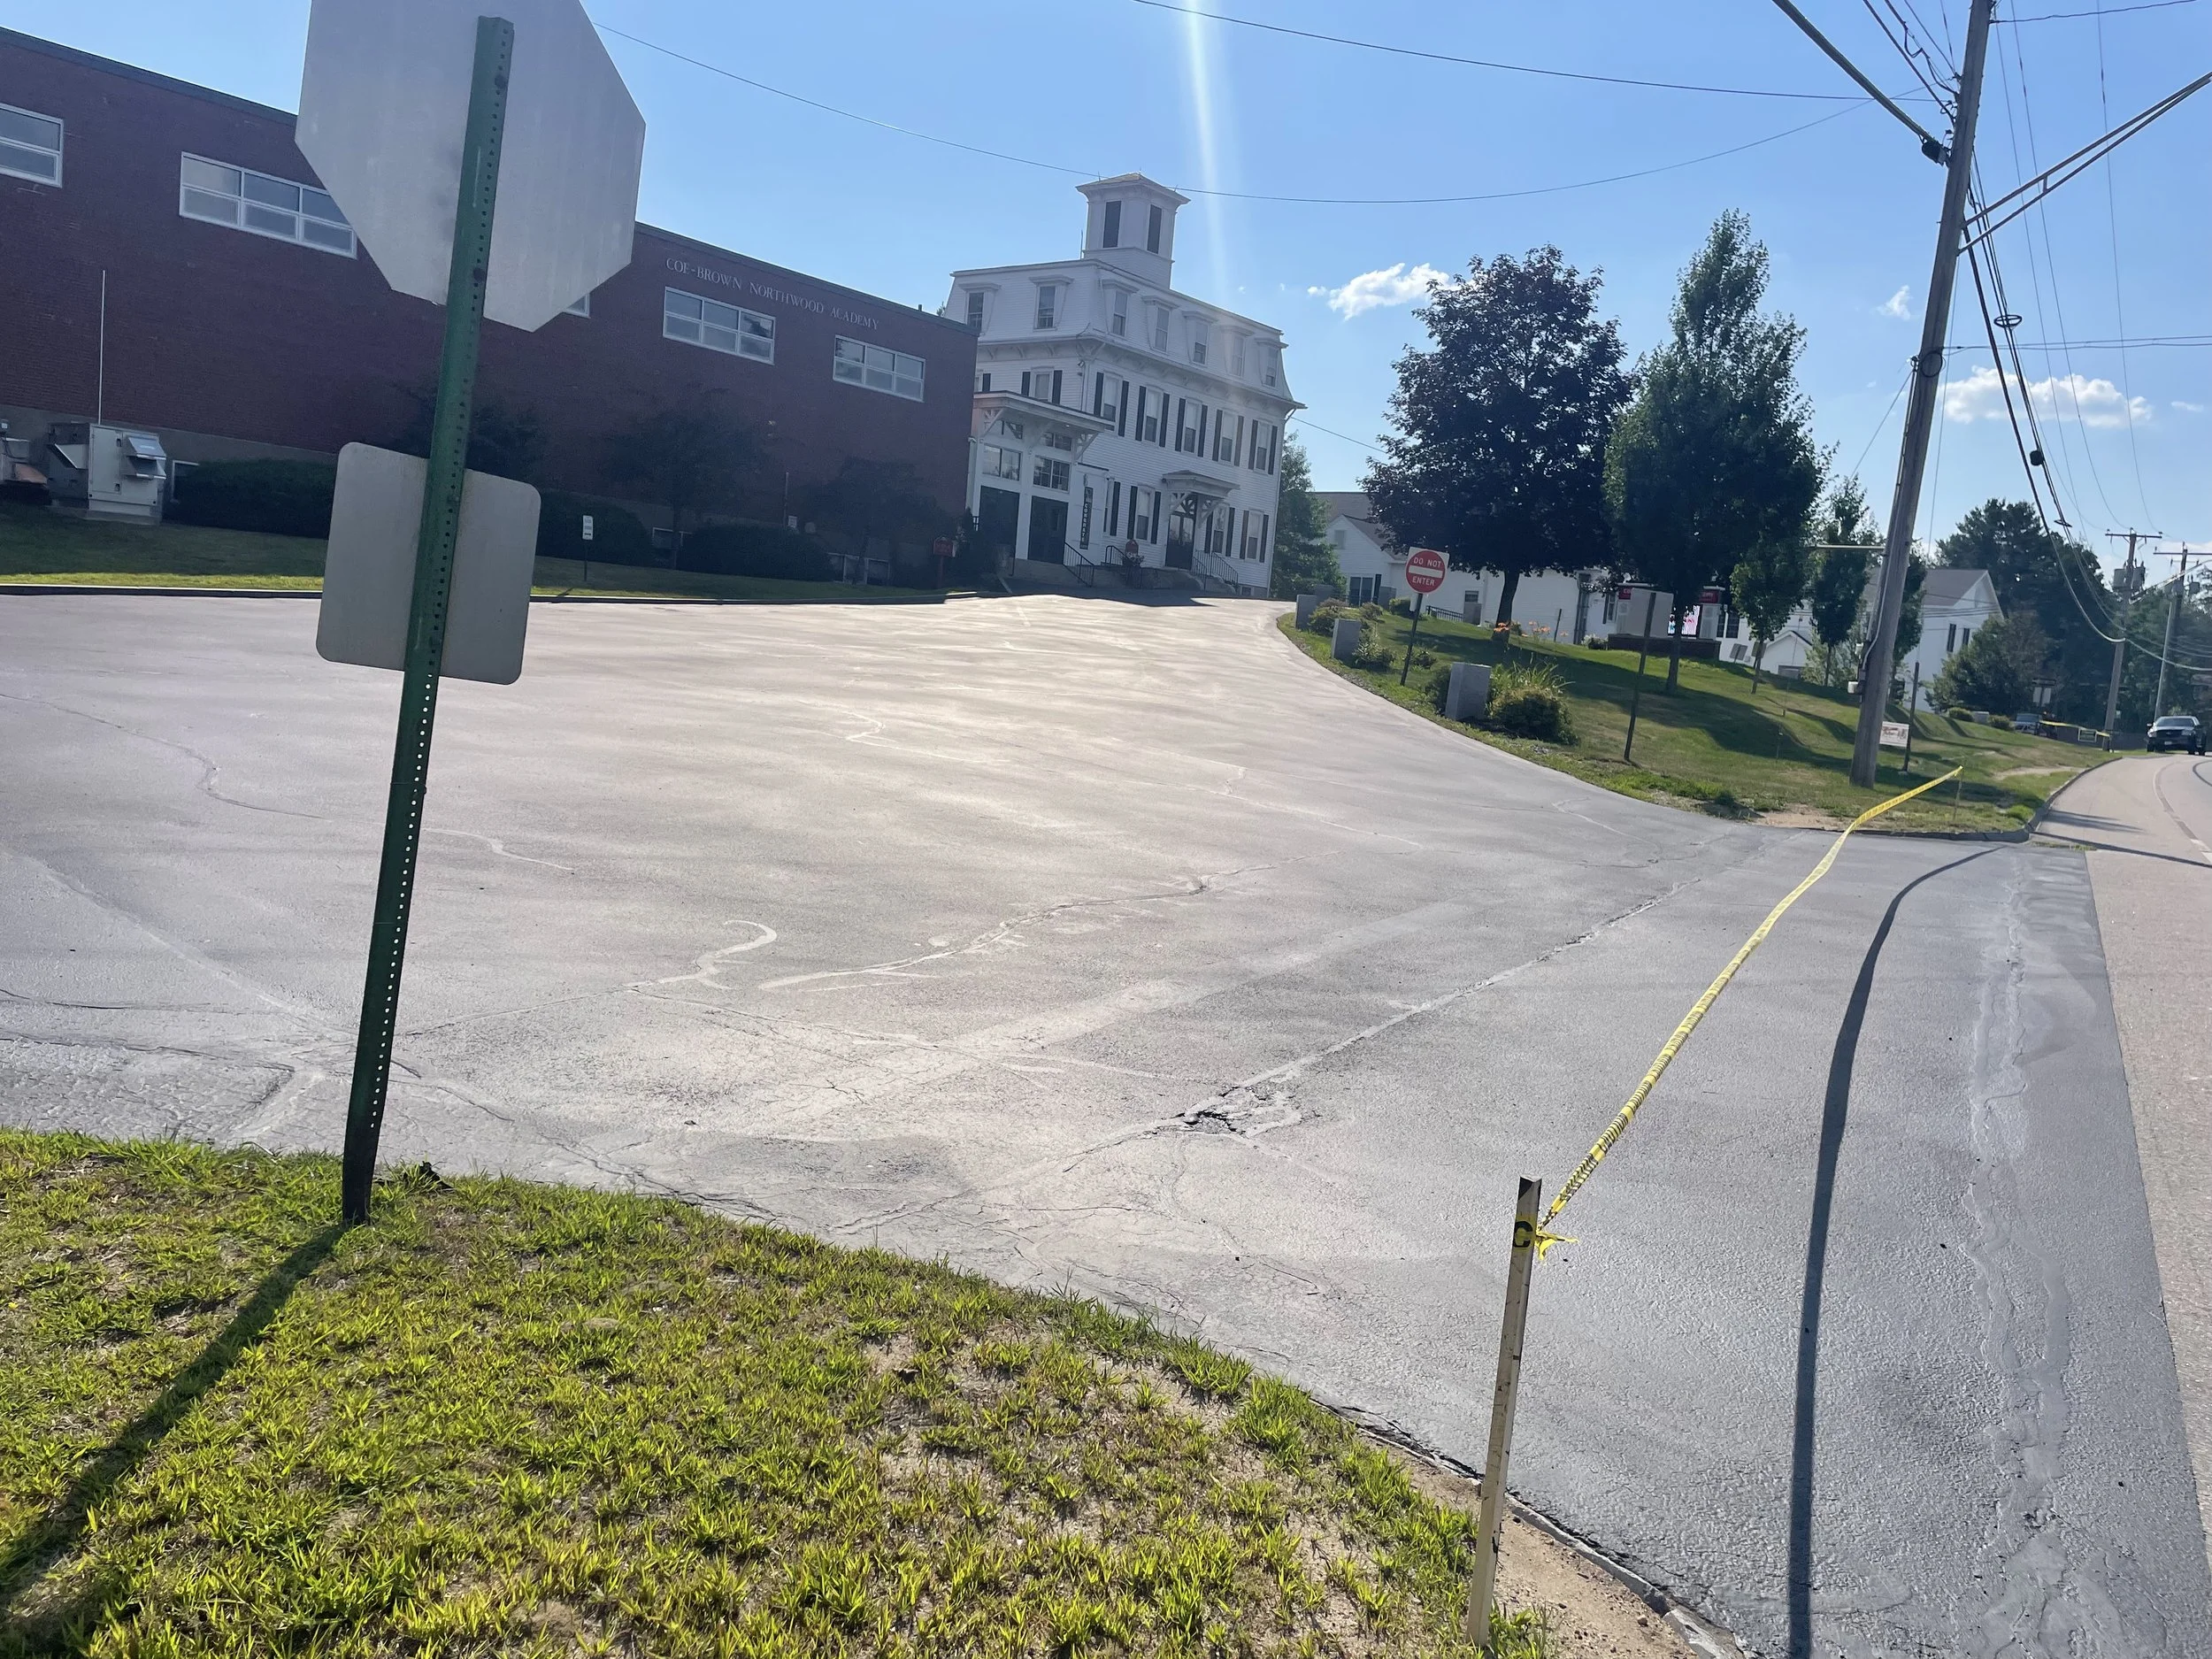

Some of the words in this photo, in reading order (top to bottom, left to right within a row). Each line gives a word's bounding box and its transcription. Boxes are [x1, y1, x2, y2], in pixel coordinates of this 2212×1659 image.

[666, 257, 741, 289] COE-BROWN
[749, 281, 824, 313] NORTHWOOD
[830, 307, 879, 330] ACADEMY
[1413, 557, 1424, 565] DO
[1426, 559, 1442, 568] NOT
[1412, 576, 1435, 586] ENTER
